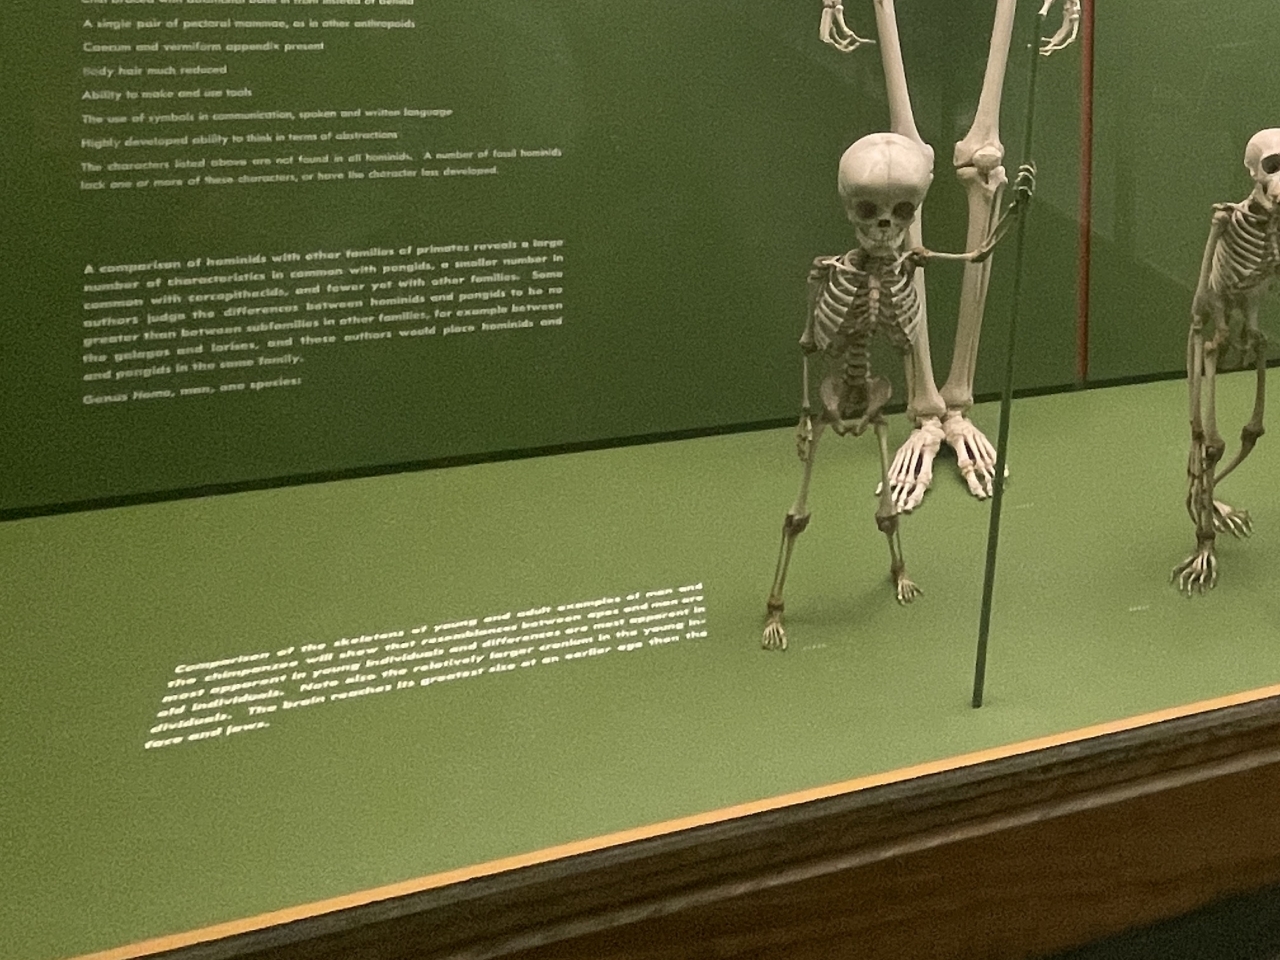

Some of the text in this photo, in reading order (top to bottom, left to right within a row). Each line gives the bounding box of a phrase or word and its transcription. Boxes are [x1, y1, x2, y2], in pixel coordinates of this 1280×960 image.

[84, 265, 94, 274] A
[99, 261, 181, 273] comparison
[187, 258, 201, 267] of
[206, 254, 266, 266] hominids
[272, 253, 300, 262] with
[305, 251, 341, 260] other
[346, 248, 394, 258] families
[399, 246, 412, 255] of
[417, 245, 469, 255] primates
[474, 241, 517, 250] reveals
[533, 240, 563, 248] large
[175, 583, 702, 673] Comparison of the skeletons of young and adult examples of man and
